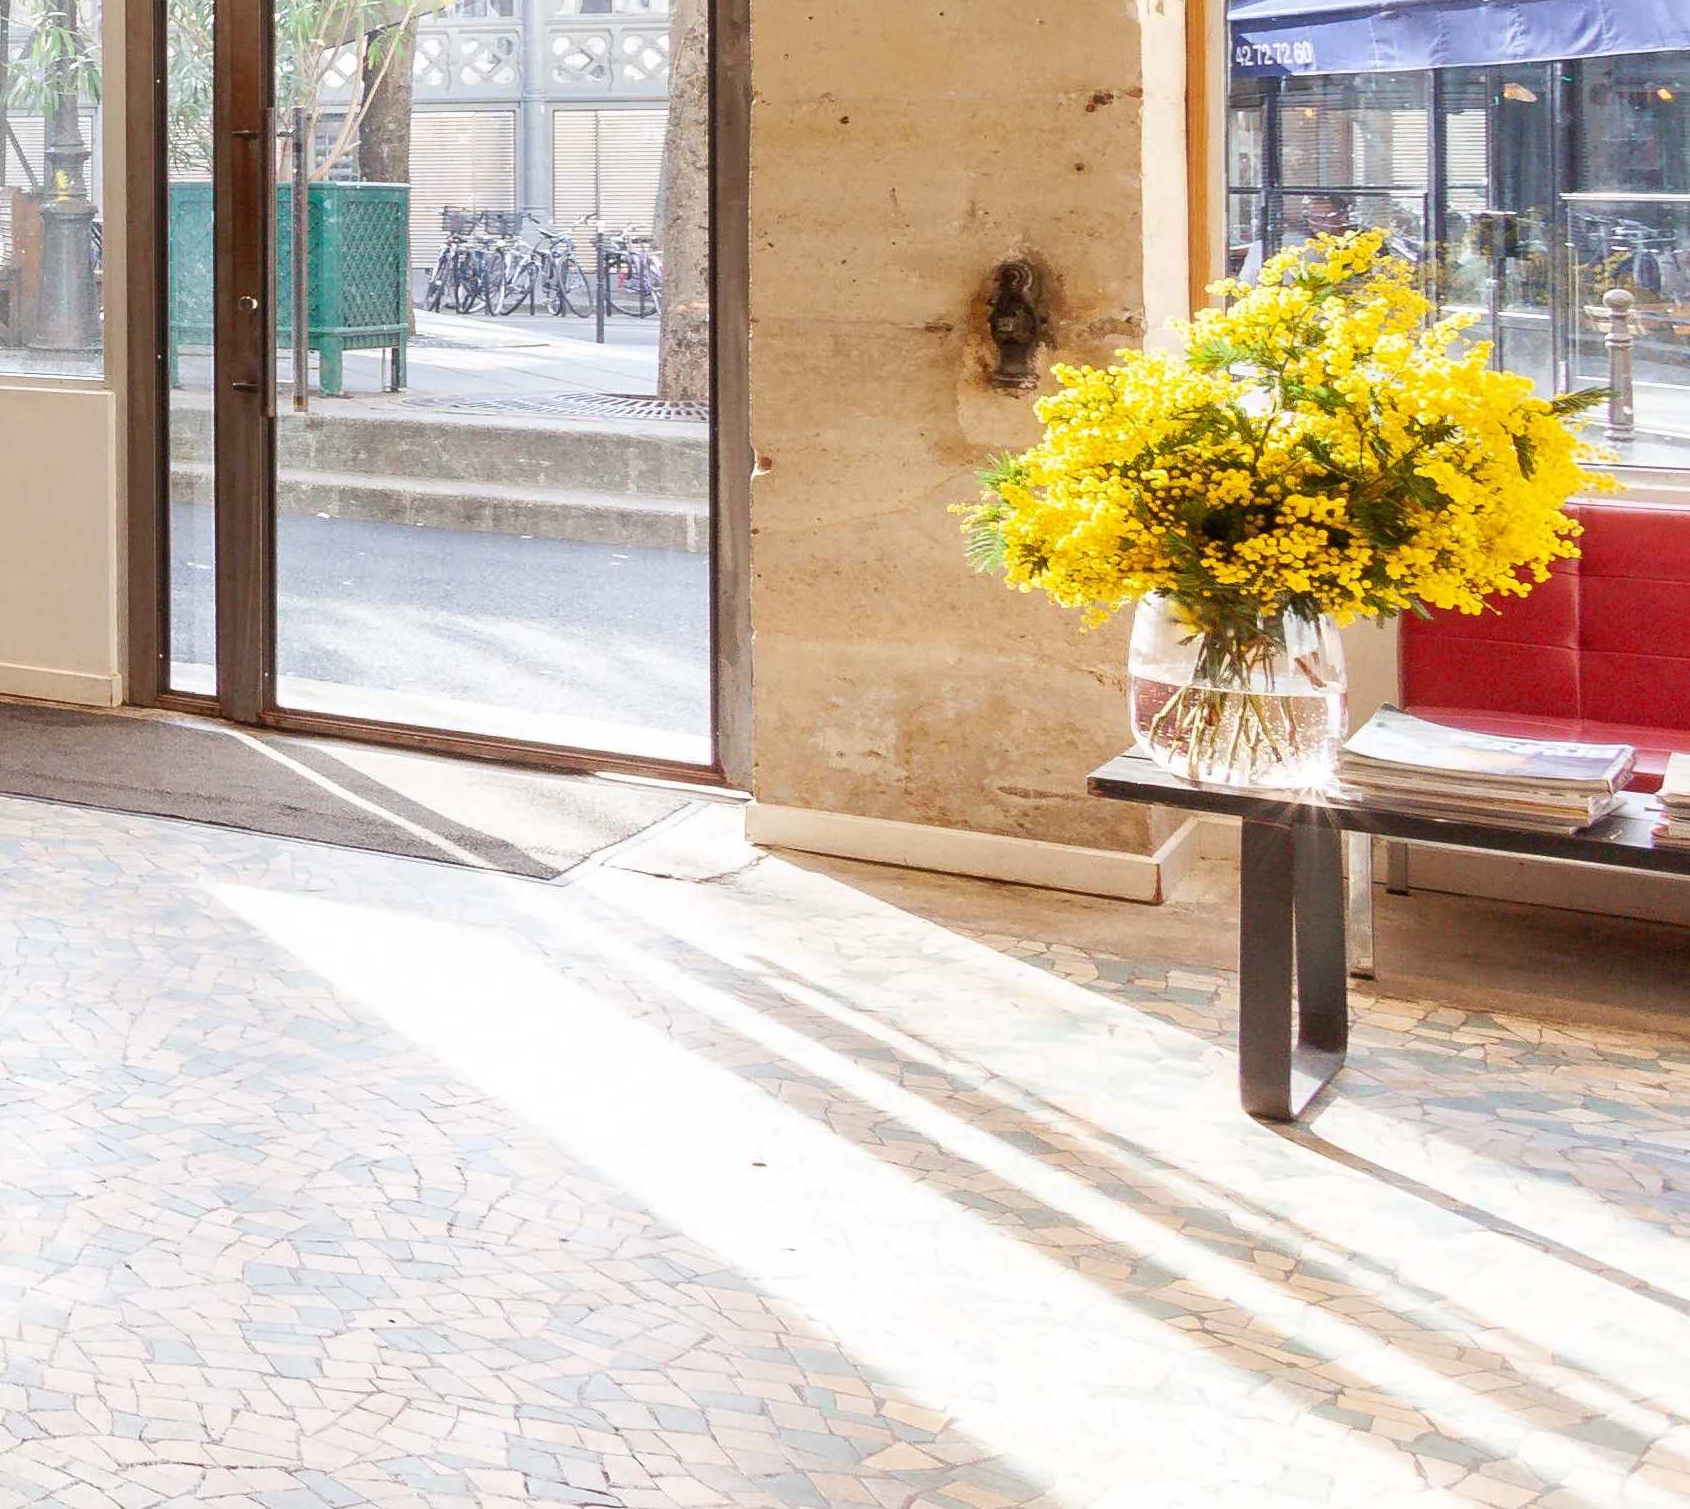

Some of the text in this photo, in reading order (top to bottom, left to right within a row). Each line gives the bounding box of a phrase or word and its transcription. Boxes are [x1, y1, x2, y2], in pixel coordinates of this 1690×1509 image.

[1235, 44, 1254, 67] 42
[1252, 43, 1273, 65] 72
[1272, 42, 1293, 65] 72
